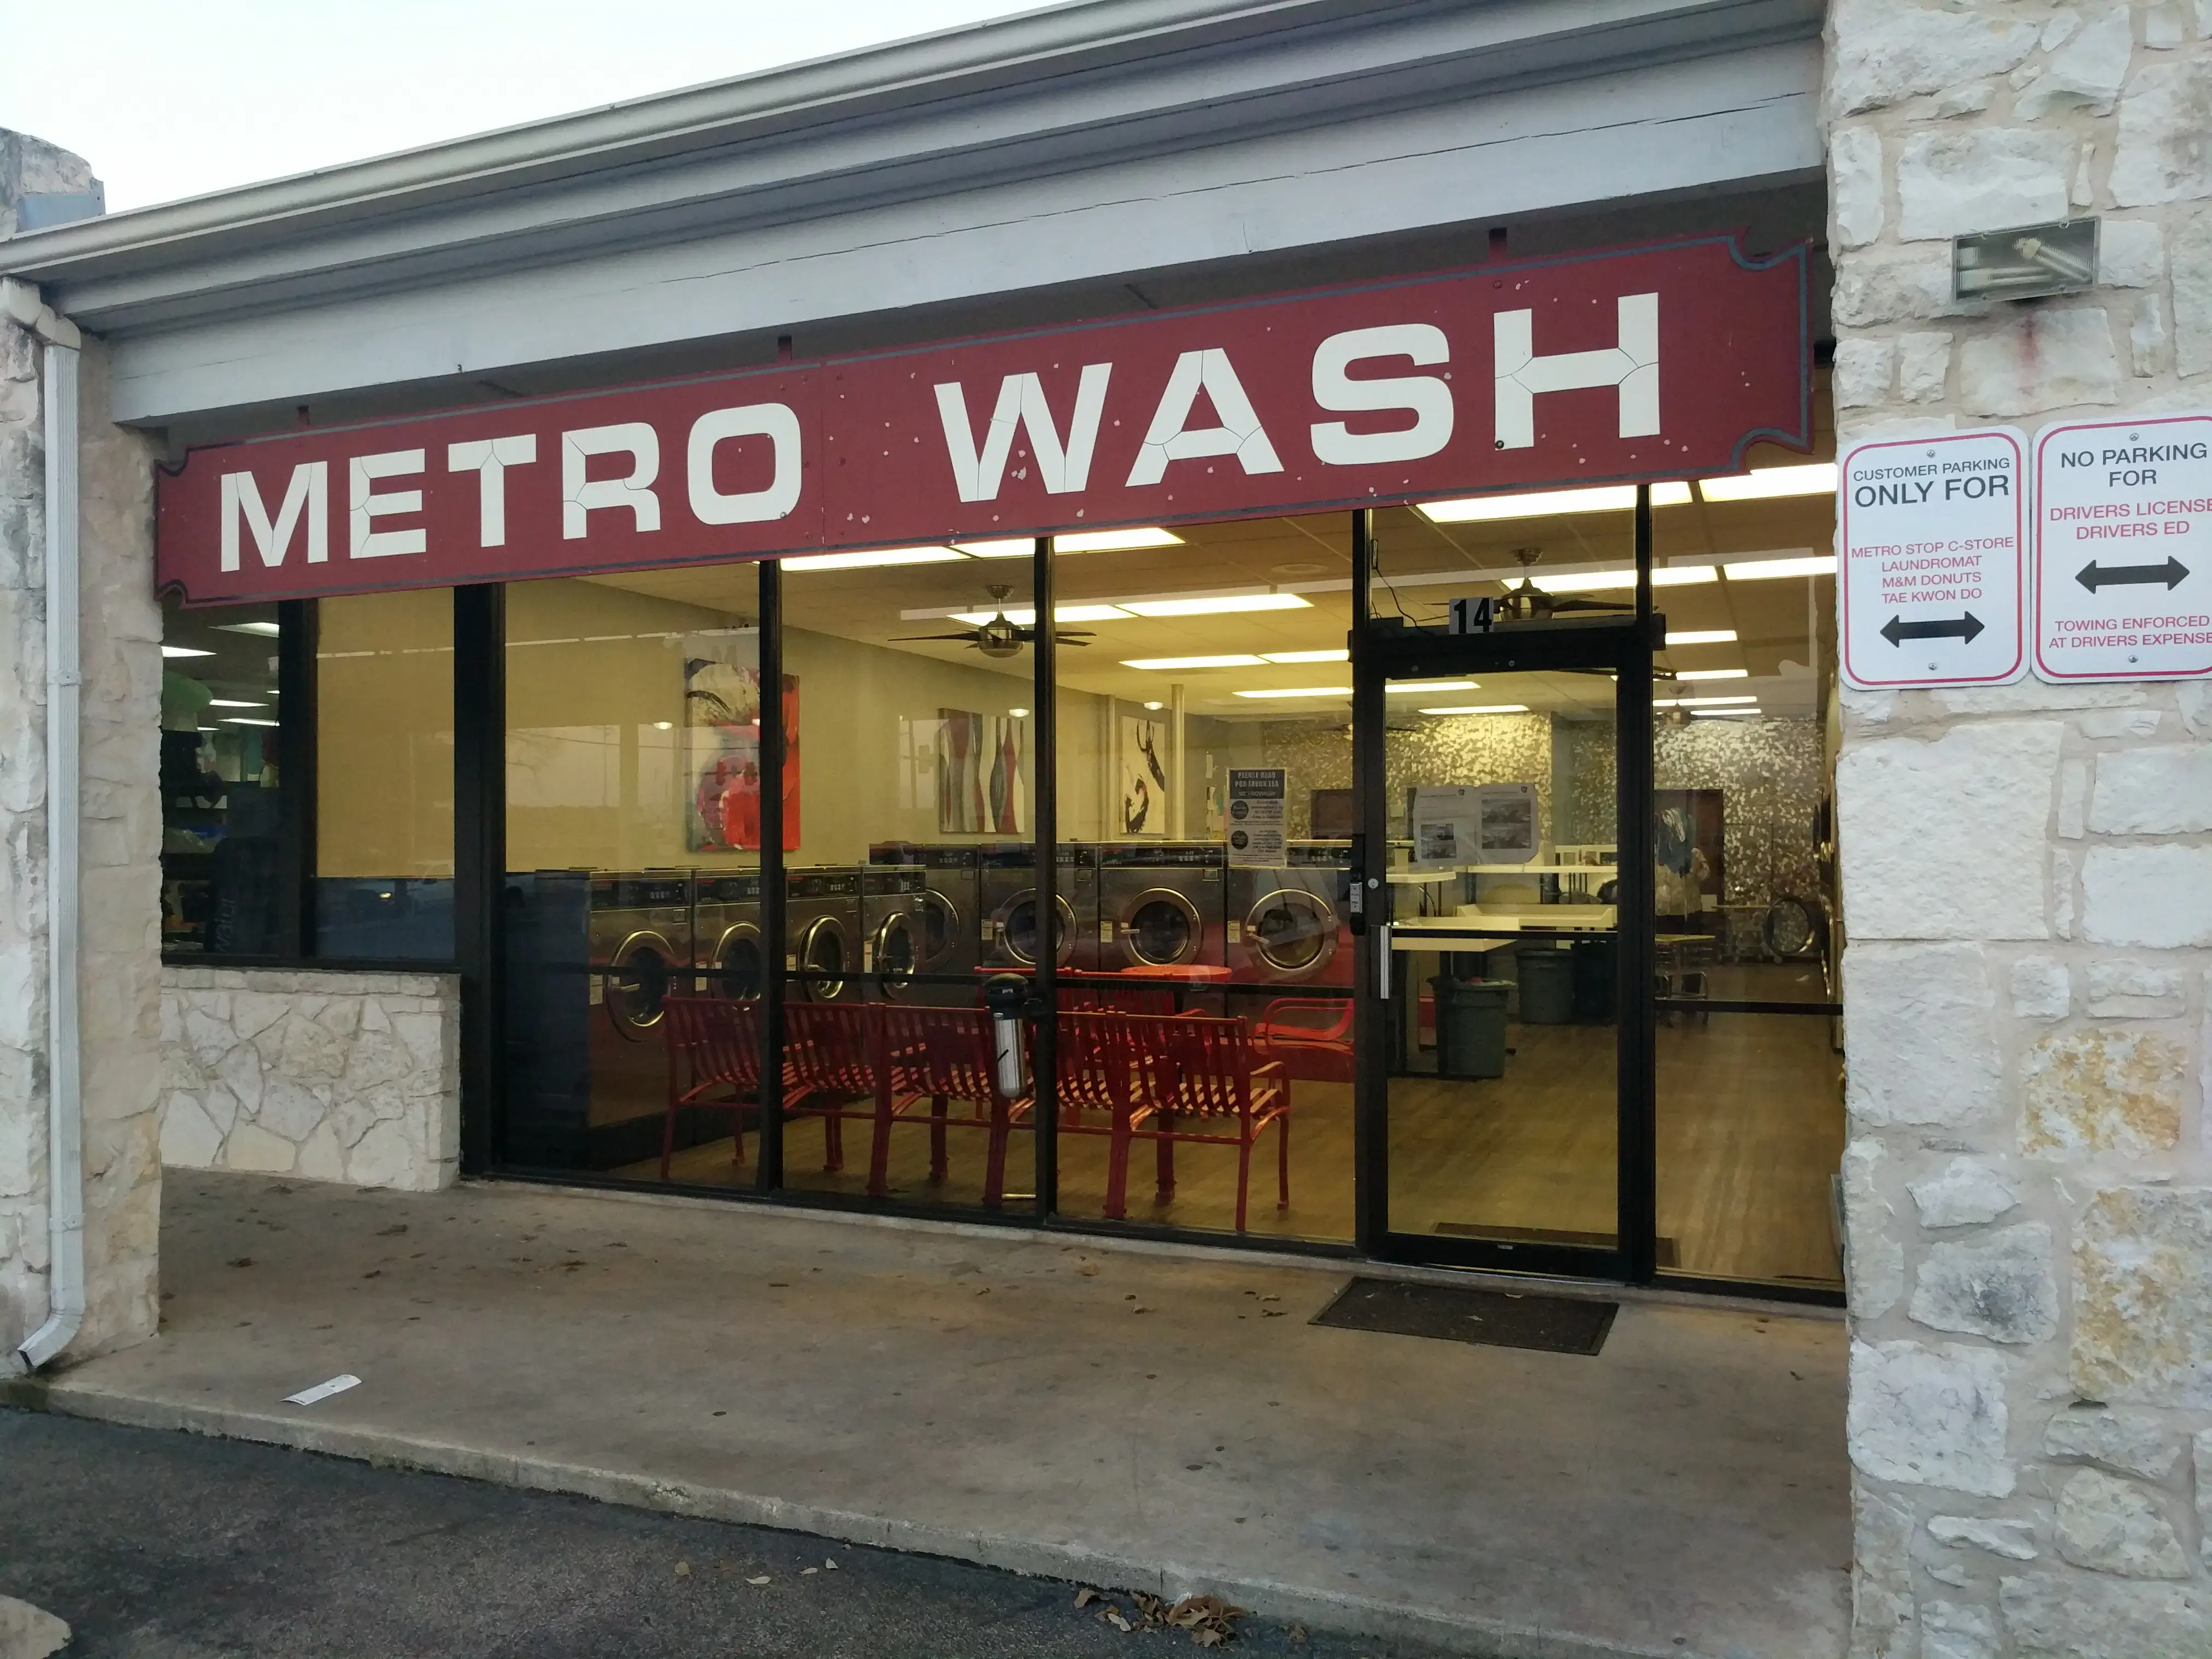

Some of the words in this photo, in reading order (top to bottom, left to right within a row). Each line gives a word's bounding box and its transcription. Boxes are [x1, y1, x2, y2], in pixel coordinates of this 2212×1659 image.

[221, 403, 802, 572] METRO
[933, 292, 1660, 503] WASH
[2061, 451, 2095, 468] NO
[2102, 443, 2207, 465] PARKING
[1854, 464, 1938, 481] CUSTOMER
[1943, 458, 2010, 474] PARKING
[2109, 469, 2157, 487] FOR
[1855, 481, 1934, 508] ONLY
[1945, 475, 2009, 501] FOR
[2050, 503, 2131, 521] DRIVERS
[2076, 522, 2157, 540] DRIVERS
[2164, 521, 2190, 535] ED
[1851, 545, 1902, 558] METRO
[1905, 542, 1944, 555] STOP
[1948, 537, 2014, 551] C-STORE
[1882, 556, 1982, 572] LAUNDROMAT
[1882, 576, 1916, 588] M&M
[1921, 572, 1982, 586] DONUTS
[1881, 592, 1907, 604] TAE
[1911, 590, 1956, 602] KWON
[1961, 588, 1982, 599] DO
[1454, 598, 1492, 633] 14
[2055, 619, 2117, 632] TOWING
[2122, 615, 2210, 629] ENFORCED
[2049, 637, 2067, 649] AT
[2072, 635, 2138, 648] DRIVERS
